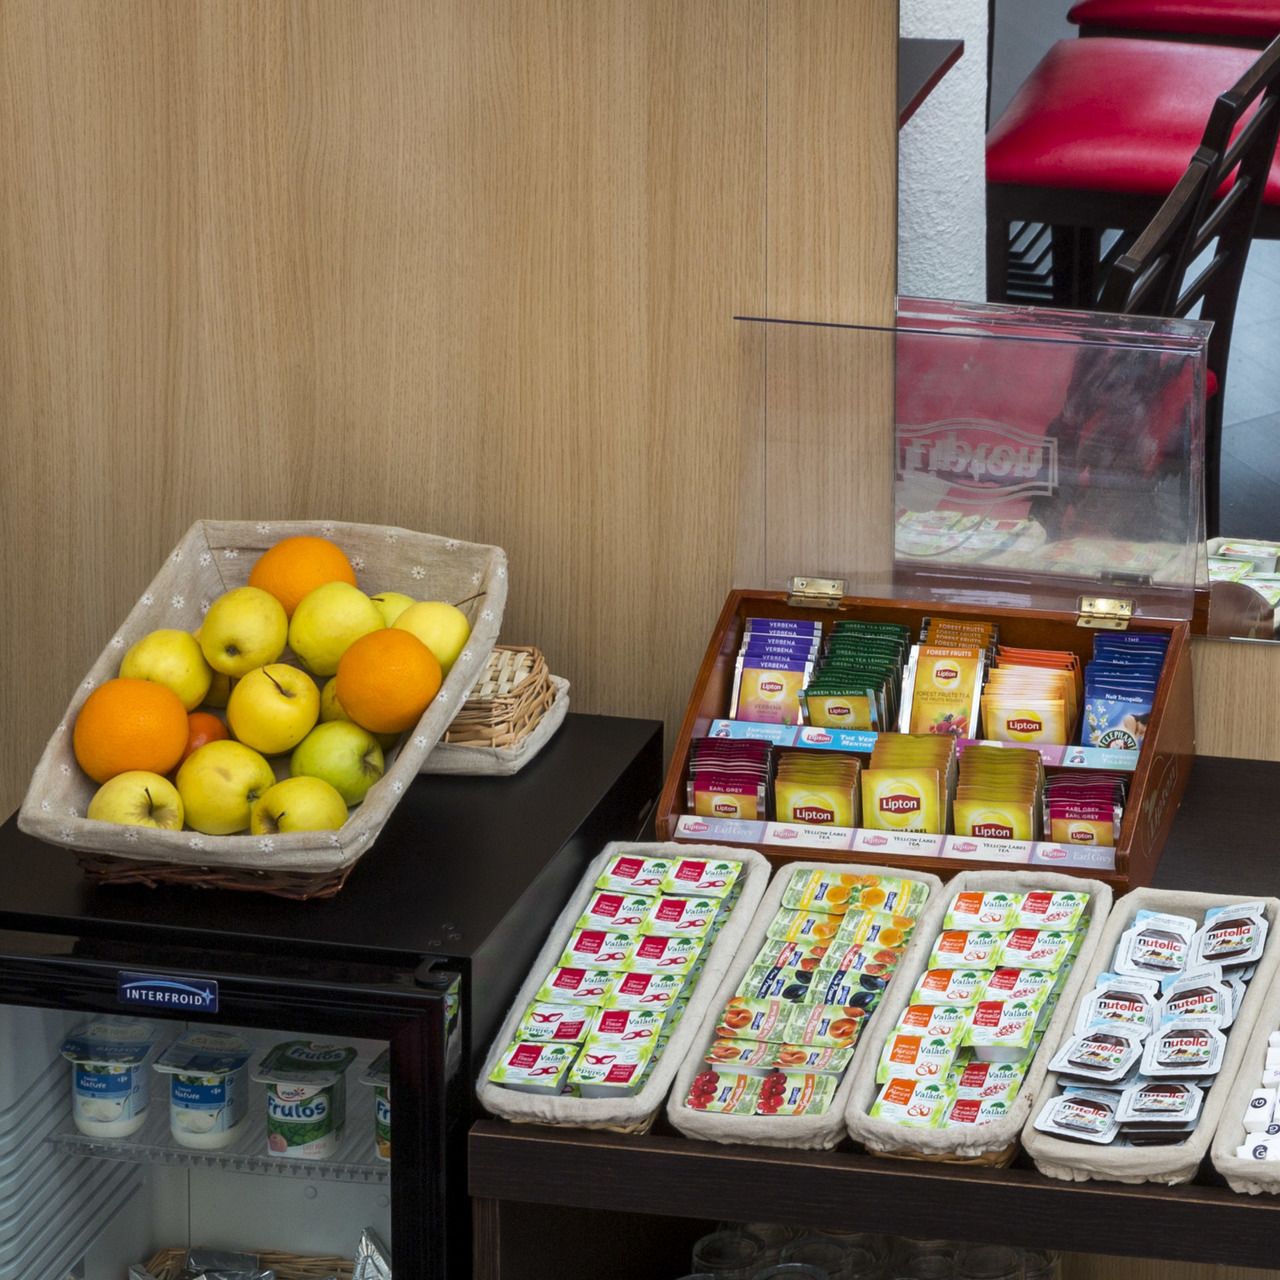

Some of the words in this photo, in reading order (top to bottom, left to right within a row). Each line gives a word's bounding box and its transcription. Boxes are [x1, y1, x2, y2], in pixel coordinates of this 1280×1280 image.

[769, 621, 798, 630] VERBENA
[767, 638, 796, 646] VERBENA
[765, 646, 793, 654] VERBENA
[760, 661, 789, 670] VERBENA
[937, 670, 957, 678] Lipton
[761, 683, 782, 692] Lipton
[828, 707, 851, 716] Lipton
[1009, 720, 1040, 733] Lipton
[807, 733, 832, 743] Lipton
[715, 804, 736, 813] Lipton
[882, 798, 918, 812] Lipton
[796, 808, 831, 822] Lipton
[684, 823, 709, 833] Lipton
[975, 826, 1010, 839] Lipton
[1072, 832, 1093, 840] Lipton
[1208, 927, 1251, 941] nutella
[1138, 938, 1182, 952] nutella
[126, 988, 203, 1006] INTERFROID
[1099, 1000, 1144, 1013] nutella
[1169, 994, 1214, 1011] nutella
[1080, 1042, 1125, 1055] nutella
[1163, 1038, 1208, 1049] nutella
[1139, 1092, 1185, 1101] nutella
[1063, 1104, 1108, 1119] nutella
